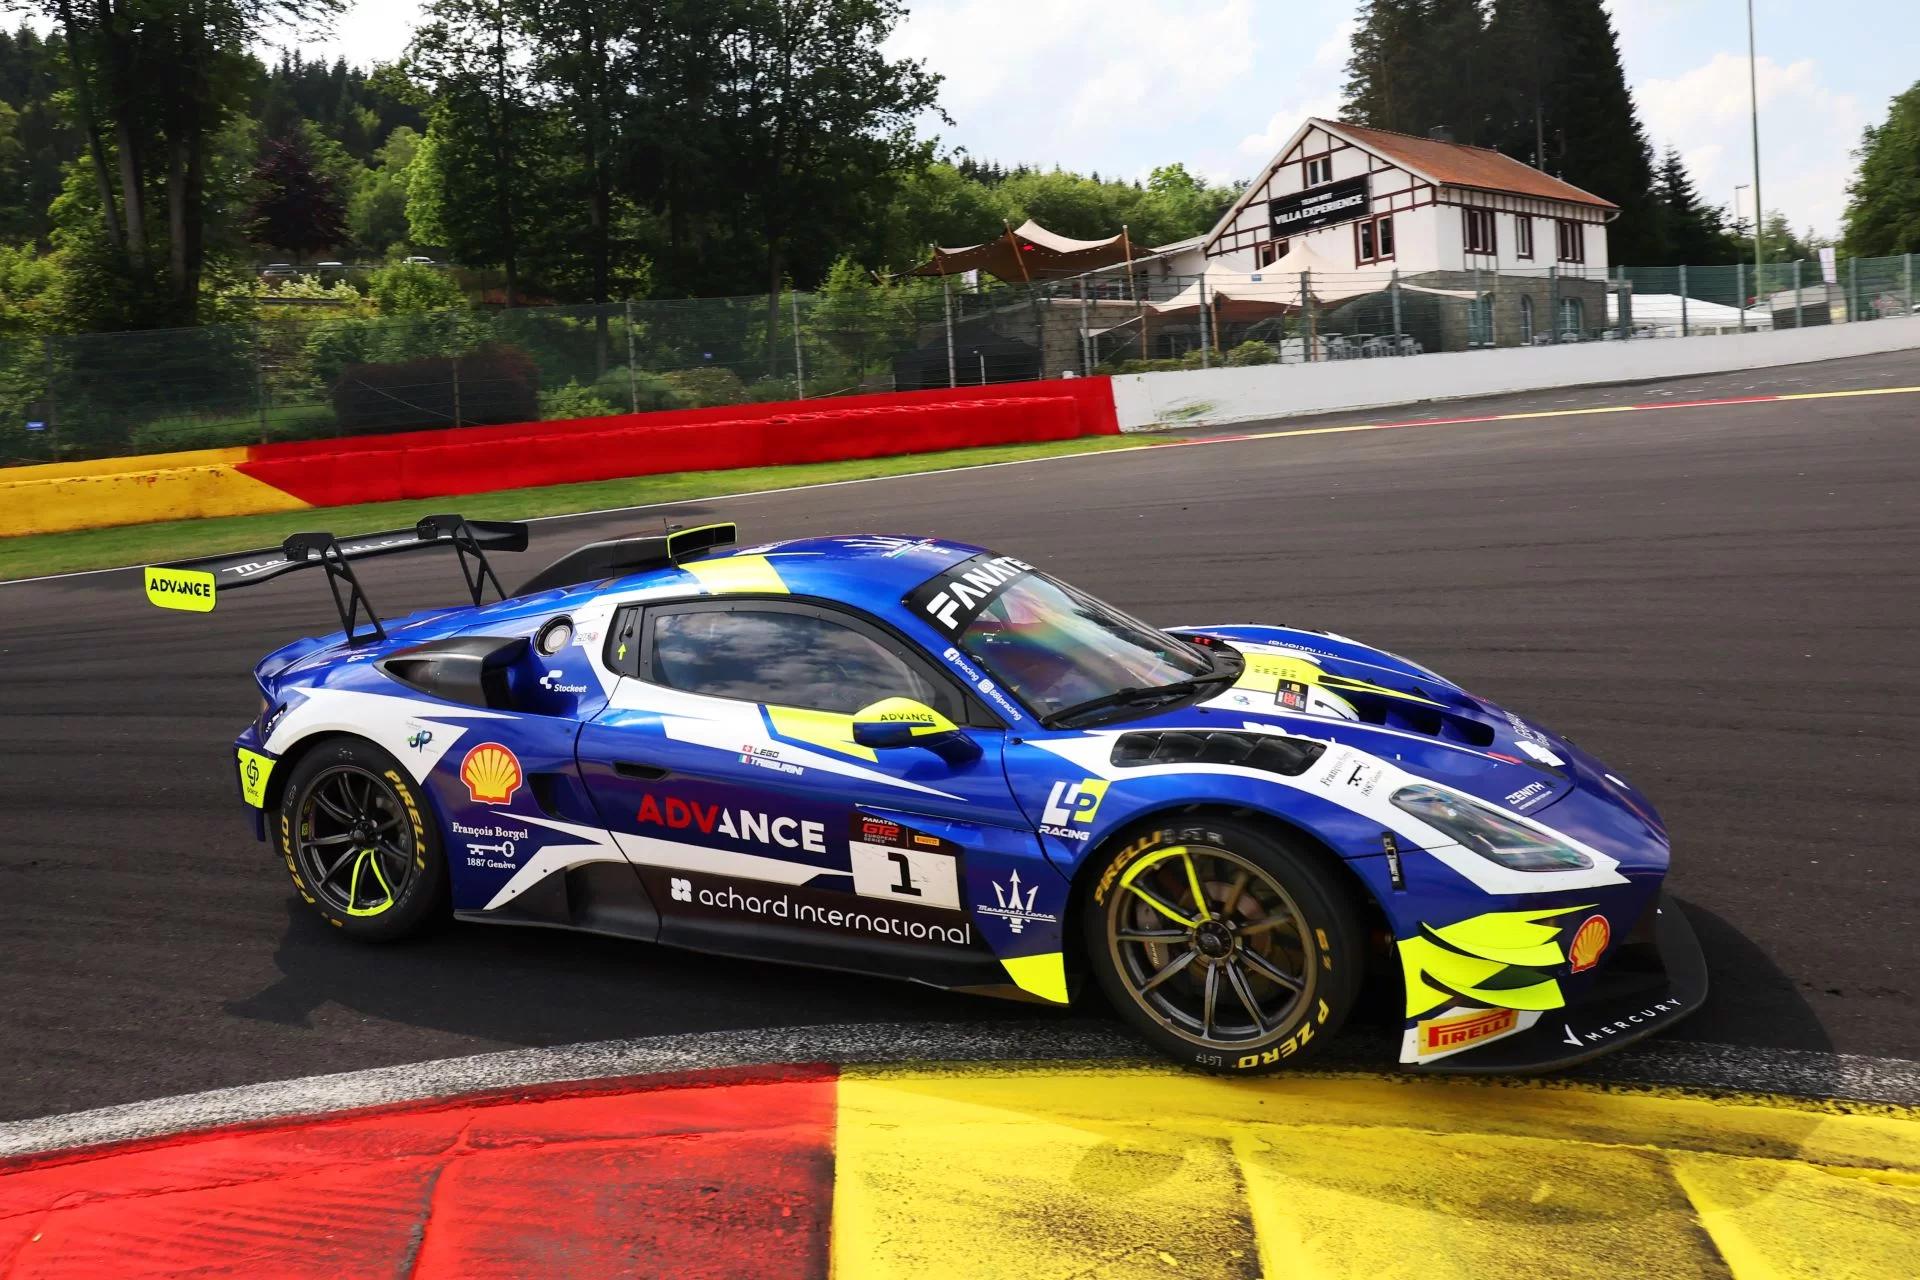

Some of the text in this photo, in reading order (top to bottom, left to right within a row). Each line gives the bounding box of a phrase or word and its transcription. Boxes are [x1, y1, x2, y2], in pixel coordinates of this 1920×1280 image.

[1274, 210, 1302, 225] VILLA
[1302, 194, 1363, 218] EXPERIENCE
[150, 578, 211, 598] ADVANCE
[880, 713, 934, 723] ADVANCE
[753, 747, 779, 758] LEGO
[1504, 781, 1546, 804] ZENITH
[384, 769, 426, 870] PIRELLI
[637, 794, 826, 853] ADVANCE
[862, 822, 900, 837] GT2
[452, 822, 528, 841] François Borgel
[864, 833, 897, 841] EUROPEAN
[864, 836, 885, 844] SERIES
[1039, 825, 1091, 841] RACING
[467, 858, 516, 869] 1887 Genève
[887, 851, 922, 897] 1
[699, 886, 971, 944] achard international
[977, 904, 1056, 919] Maserati Corse
[1428, 1009, 1512, 1047] PIRELLI
[1585, 998, 1682, 1043] MERCURY
[1238, 998, 1330, 1069] P ZERO
